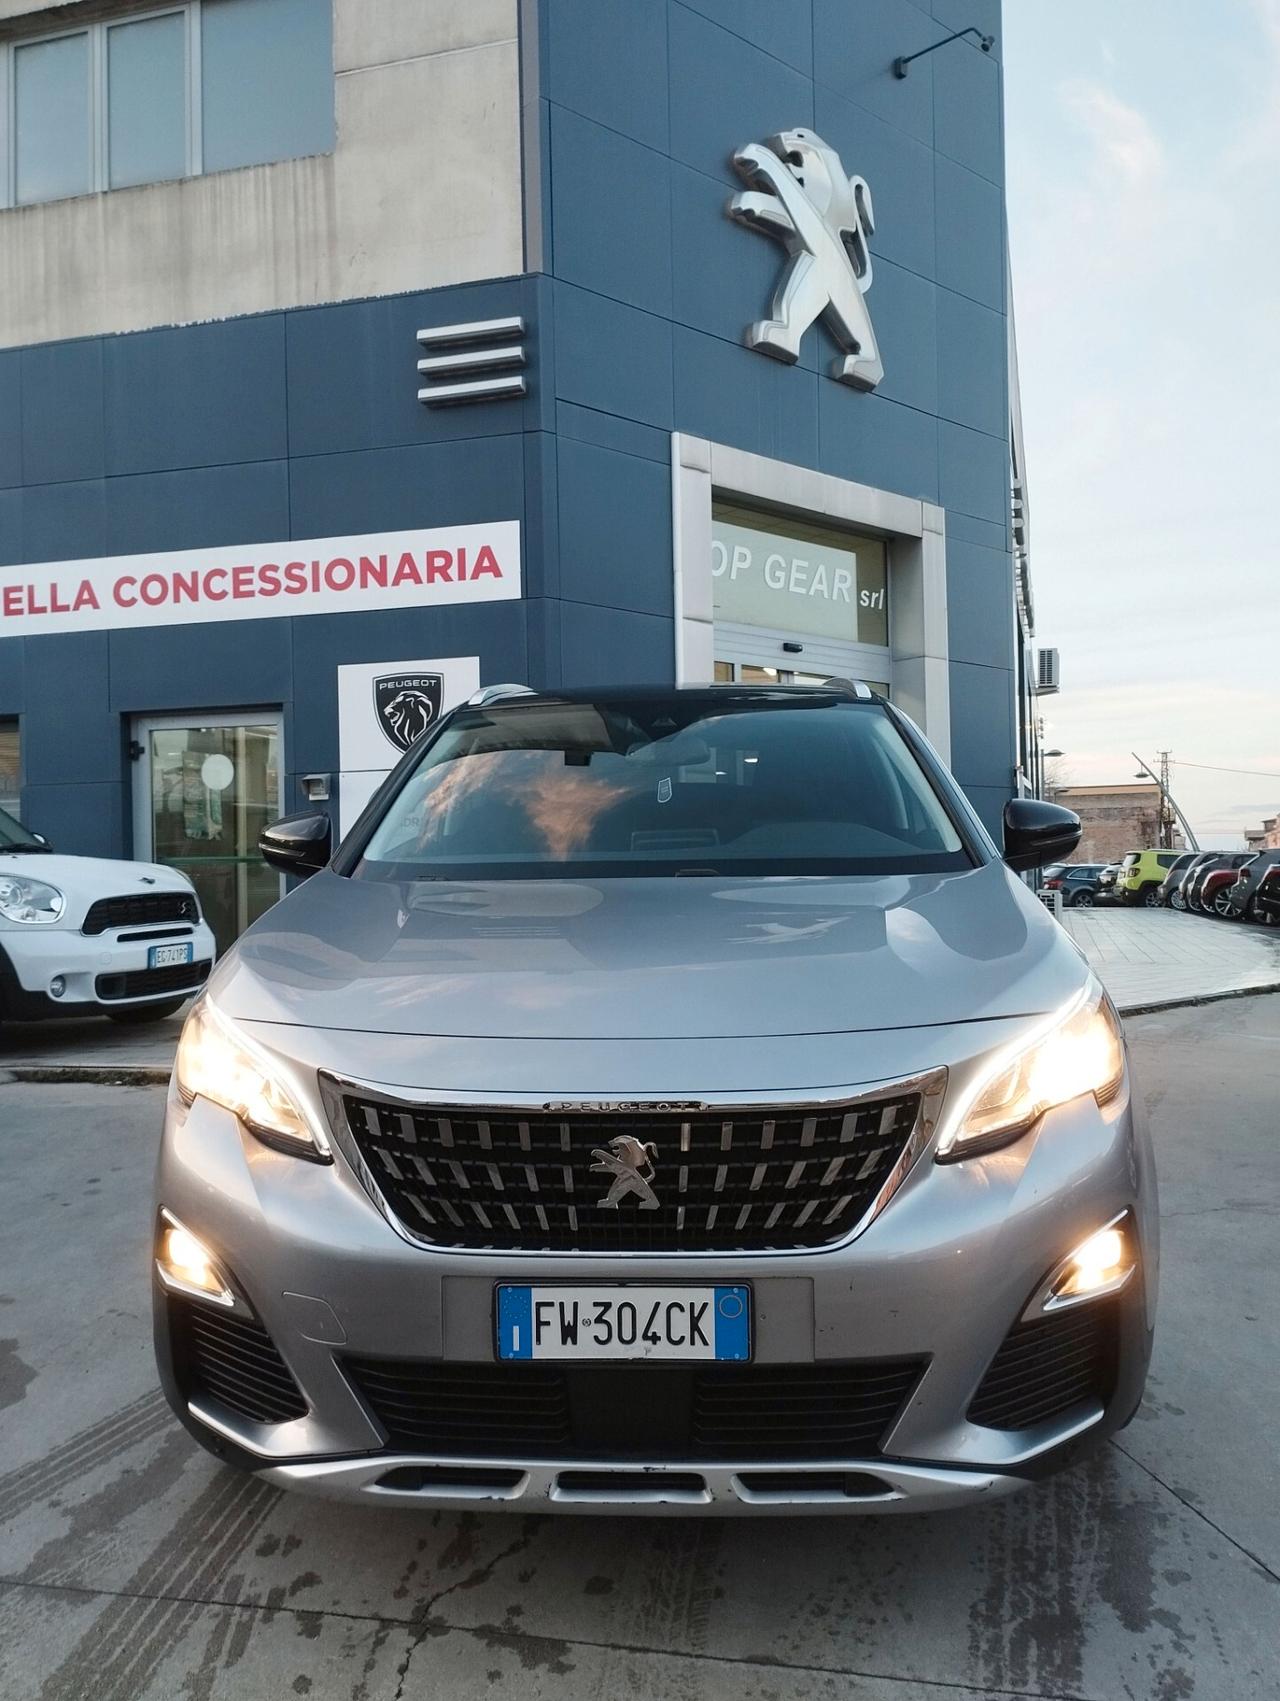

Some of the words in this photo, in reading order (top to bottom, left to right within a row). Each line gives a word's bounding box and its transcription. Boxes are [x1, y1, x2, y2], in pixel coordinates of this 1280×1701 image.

[3, 579, 100, 616] ELLA
[113, 545, 503, 608] CONCESSIONARIA
[712, 541, 752, 580] OP
[764, 554, 851, 602] GEAR
[860, 588, 885, 610] srl
[380, 679, 437, 690] PEUGEOT
[560, 1101, 690, 1113] PEUGEOT
